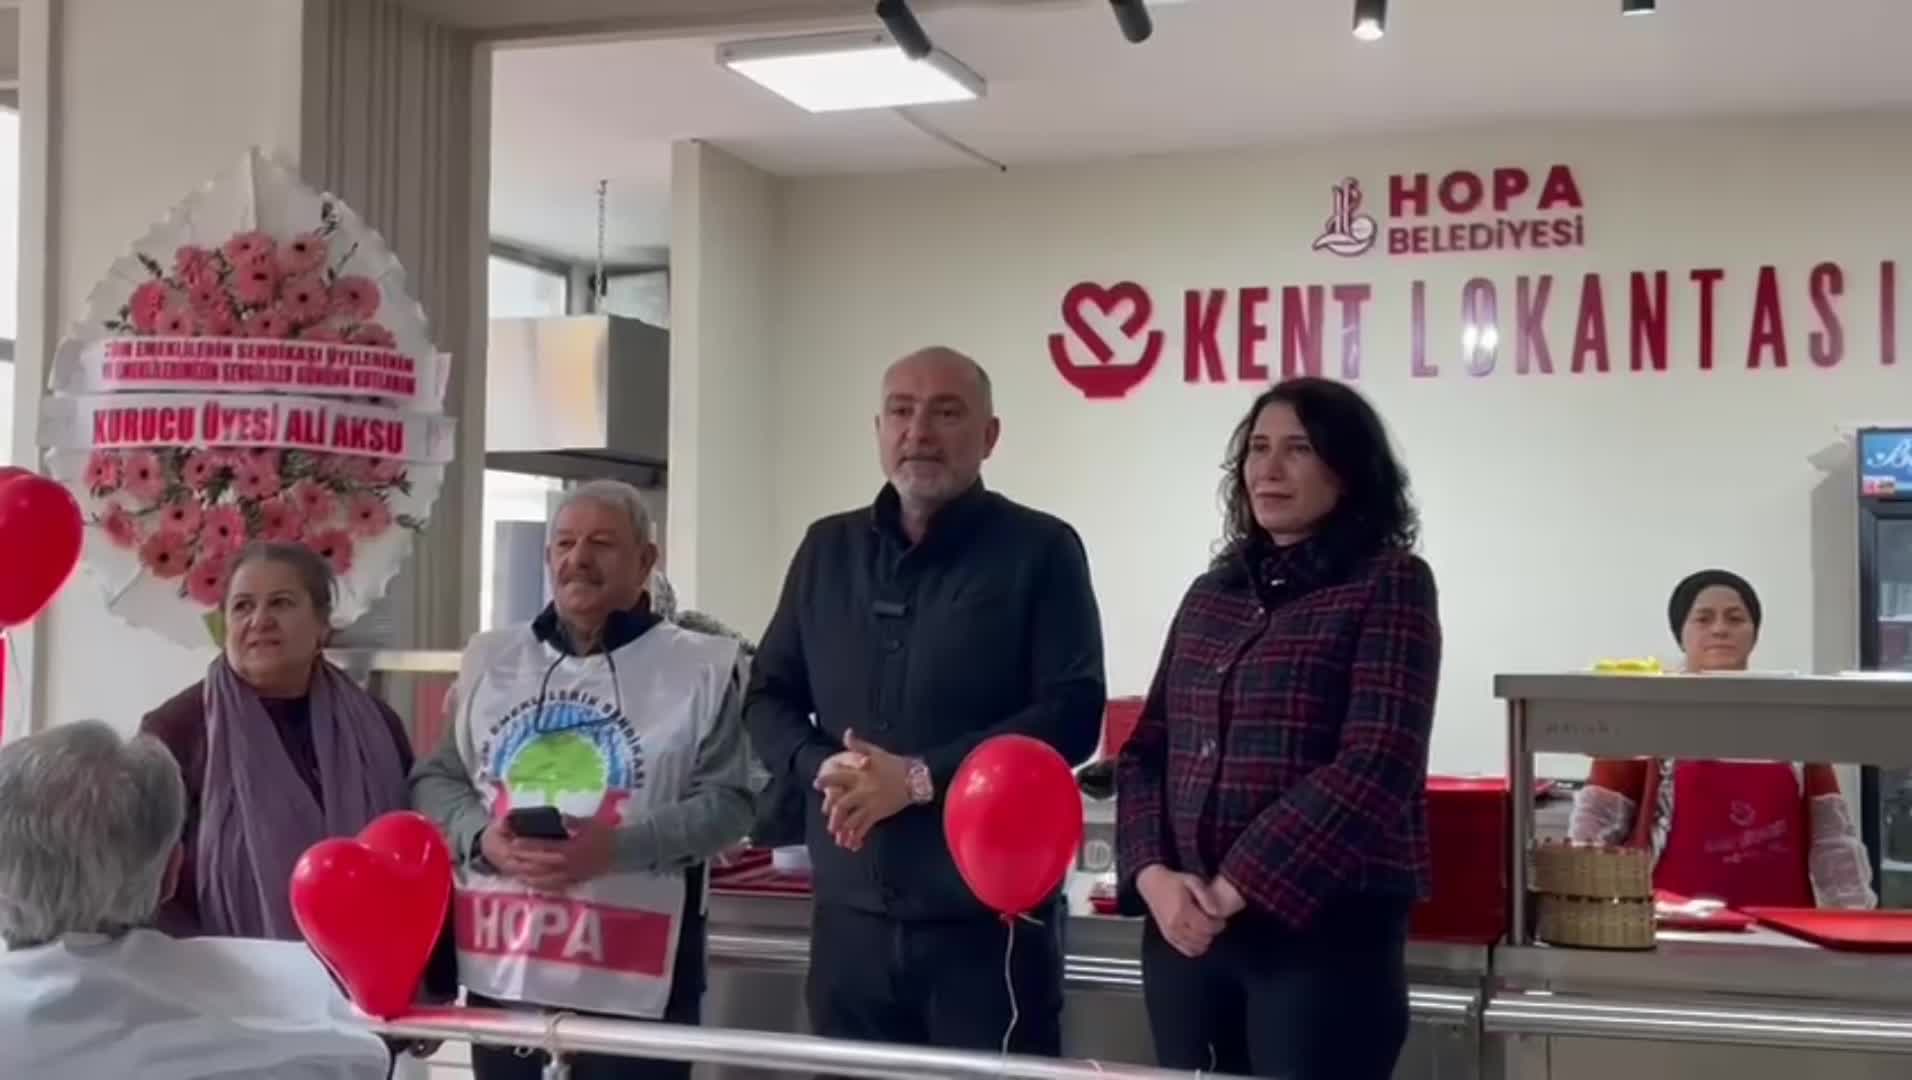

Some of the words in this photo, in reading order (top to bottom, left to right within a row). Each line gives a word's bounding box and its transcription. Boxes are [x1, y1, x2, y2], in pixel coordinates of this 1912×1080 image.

[1388, 164, 1584, 218] HOPA
[1388, 215, 1585, 255] BELEDİYESİ
[1182, 284, 1372, 383] KENT
[1409, 260, 1896, 378] LOKANTASI
[92, 405, 196, 445] KURUCU
[202, 400, 279, 444] ÜYESİ
[285, 405, 326, 445] ALİ
[331, 414, 405, 455] AKSU
[472, 897, 604, 962] HOPA
